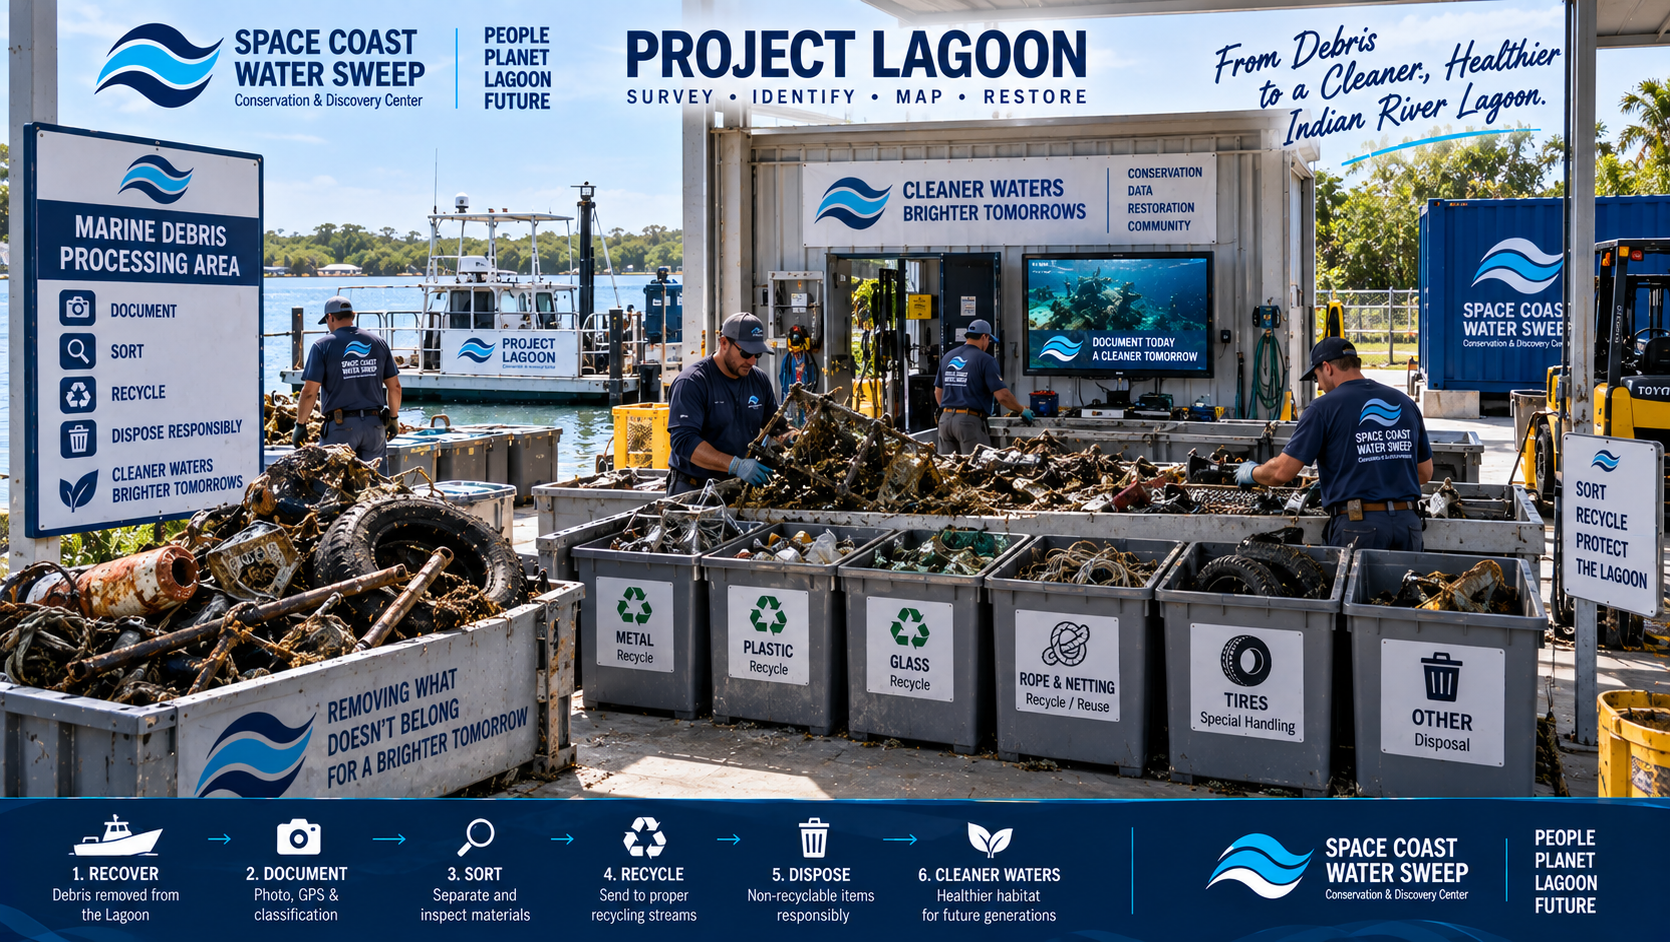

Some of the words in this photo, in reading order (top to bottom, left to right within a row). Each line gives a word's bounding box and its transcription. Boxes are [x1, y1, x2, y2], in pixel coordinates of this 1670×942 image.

[1128, 167, 1202, 178] CONSERVATION
[903, 181, 984, 199] CLEANER
[990, 179, 1063, 197] WATERS
[1128, 185, 1153, 196] DATA
[904, 205, 978, 221] BRIGHTER
[984, 203, 1086, 220] TOMORROWS
[1128, 203, 1194, 213] RESTORATION
[76, 215, 155, 242] MARINE
[163, 222, 226, 246] DEBRIS
[1128, 220, 1190, 231] COMMUNITY
[61, 247, 187, 274] PROCESSING
[194, 254, 240, 276] AREA
[111, 303, 177, 318] DOCUMENT
[1464, 303, 1514, 318] SPACE
[1520, 302, 1571, 318] COAS
[1463, 321, 1517, 336] WATER
[503, 338, 555, 349] PROJECT
[1093, 337, 1143, 347] DOCUMENT
[1146, 338, 1175, 347] TODAY
[1463, 339, 1507, 347] Conservation
[111, 344, 144, 359] SORT
[503, 352, 555, 363] LAGOON
[1093, 351, 1098, 360] A
[1102, 351, 1141, 360] CLEANER
[1144, 352, 1197, 361] TOMORROW
[112, 385, 165, 401] RECYCLE
[112, 425, 164, 443] DISPOSE
[169, 420, 242, 438] RESPONSIBLY
[1356, 431, 1385, 445] SPACE
[1386, 429, 1410, 442] COAST
[1357, 441, 1387, 456] WATER
[1387, 439, 1412, 451] SWEEP
[113, 463, 168, 484] CLEANER
[170, 459, 213, 476] WATERS
[113, 479, 170, 503] BRIGHTER
[172, 473, 245, 499] TOMORROWS
[1576, 481, 1606, 500] SORT
[1577, 507, 1627, 530] RECYCLE
[1576, 533, 1628, 560] PROTECT
[1576, 558, 1597, 577] THE
[1601, 564, 1647, 589] LAGOON
[617, 631, 654, 646] METAL
[618, 649, 653, 664] Recycle
[744, 640, 793, 658] PLASTIC
[750, 660, 788, 676] Recycle
[891, 655, 929, 672] GLASS
[891, 675, 930, 691] Recycle
[1020, 672, 1049, 687] ROPE
[1054, 676, 1061, 689] &
[1066, 677, 1114, 698] NETTING
[328, 682, 410, 725] REMOVING
[415, 668, 458, 703] WHAT
[1024, 693, 1065, 712] Recycle
[1069, 697, 1074, 710] /
[1078, 698, 1109, 712] Reuse
[1224, 692, 1268, 710] TIRES
[400, 697, 461, 738] BELONG
[1201, 711, 1241, 727] Special
[1243, 716, 1295, 737] Handling
[1412, 709, 1472, 731] OTHER
[328, 761, 359, 788] FOR
[362, 757, 372, 778] A
[375, 734, 447, 773] BRIGHTER
[450, 704, 530, 749] TOMORROW
[1415, 730, 1472, 751] Disposal
